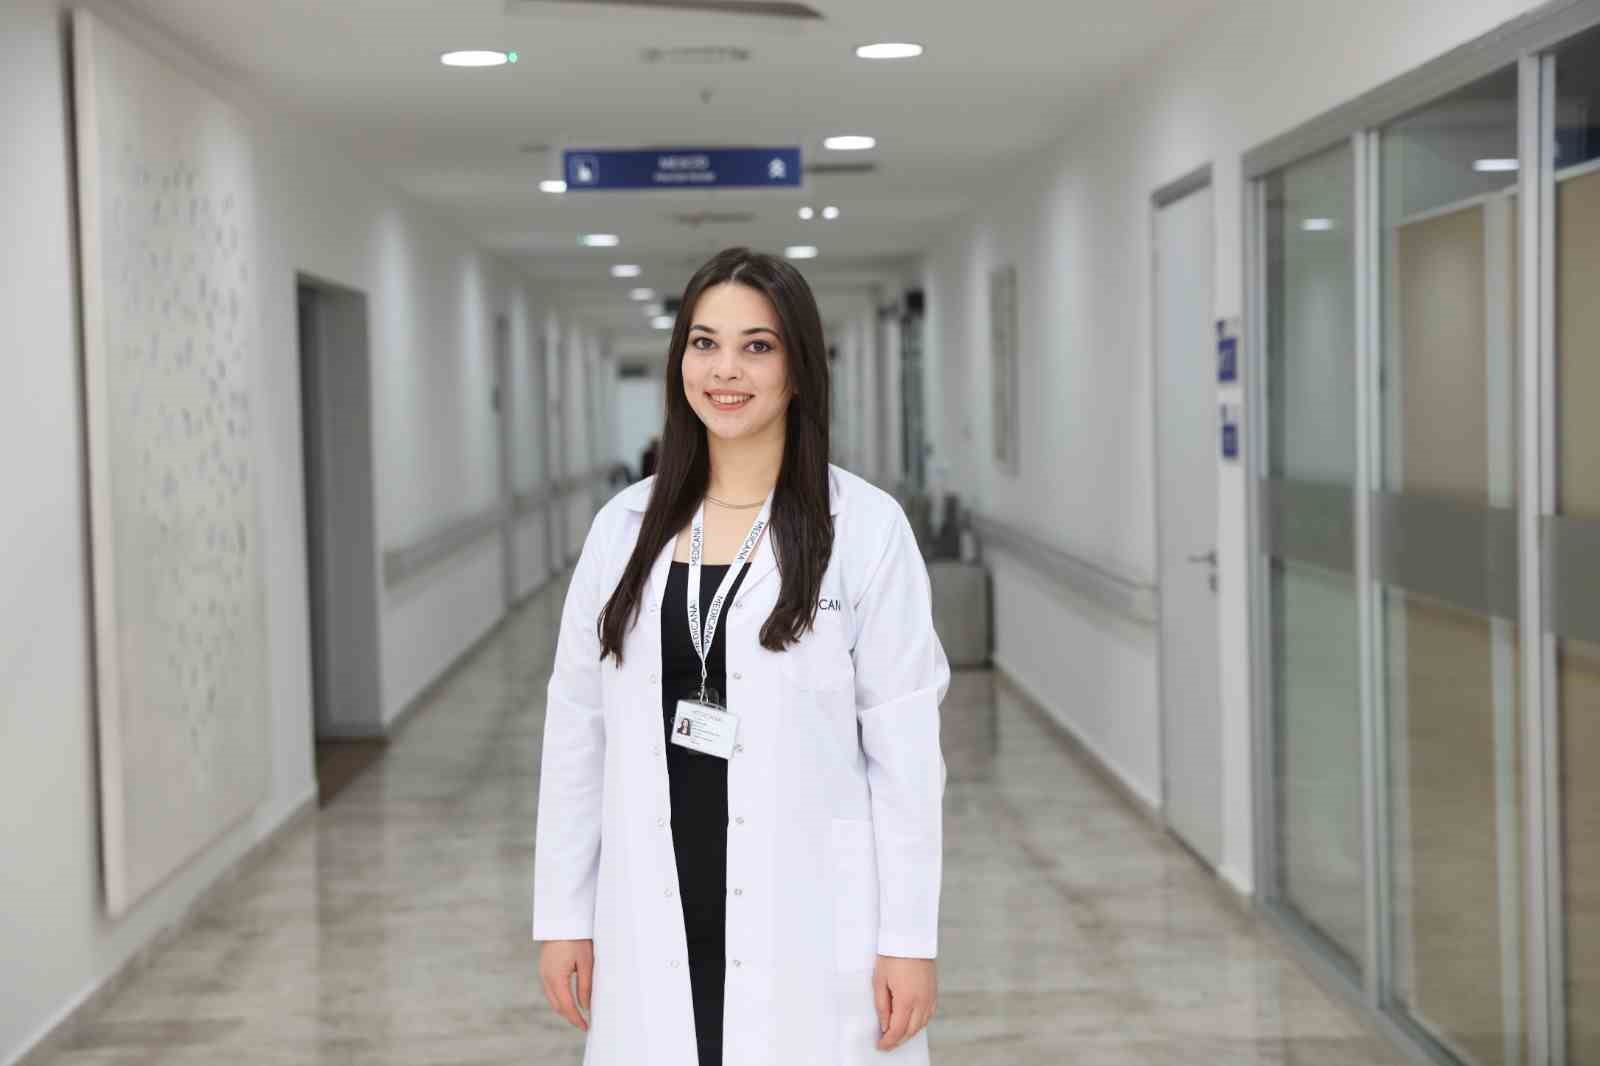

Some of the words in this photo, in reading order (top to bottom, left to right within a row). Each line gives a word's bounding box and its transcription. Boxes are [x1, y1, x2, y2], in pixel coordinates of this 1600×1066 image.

[691, 526, 702, 567] MEDICANA
[736, 520, 764, 560] MEDICANA
[704, 595, 724, 645] MEDICANA
[818, 598, 841, 611] CAN
